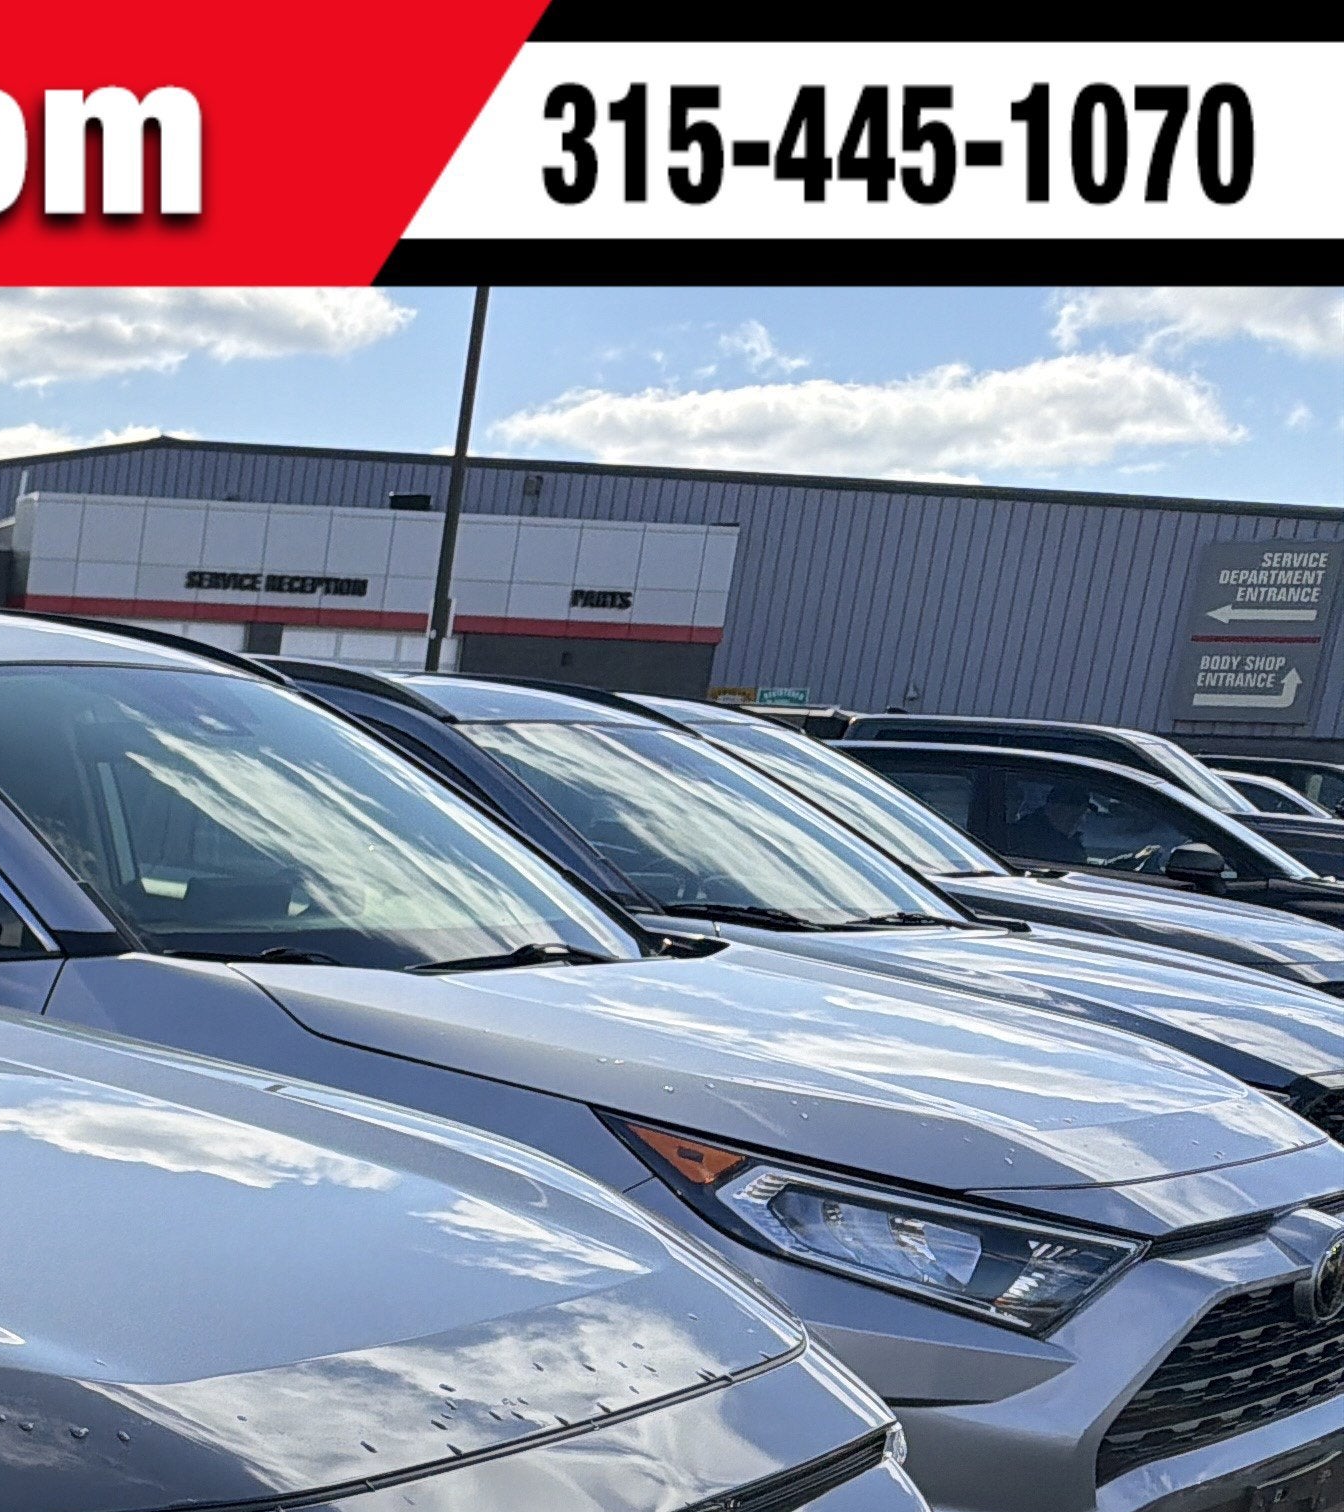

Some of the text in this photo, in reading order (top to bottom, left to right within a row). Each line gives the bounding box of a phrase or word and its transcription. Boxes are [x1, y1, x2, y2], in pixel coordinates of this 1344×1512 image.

[1262, 552, 1329, 568] SERVICE
[185, 571, 368, 596] SERVICE RECEPTION
[1219, 570, 1325, 585] DEPARTMENT
[571, 589, 633, 610] PARTS
[1236, 587, 1321, 602] ENTRANCE
[1200, 655, 1286, 671] BODY SHOP
[1197, 672, 1277, 687] ENTRANCE
